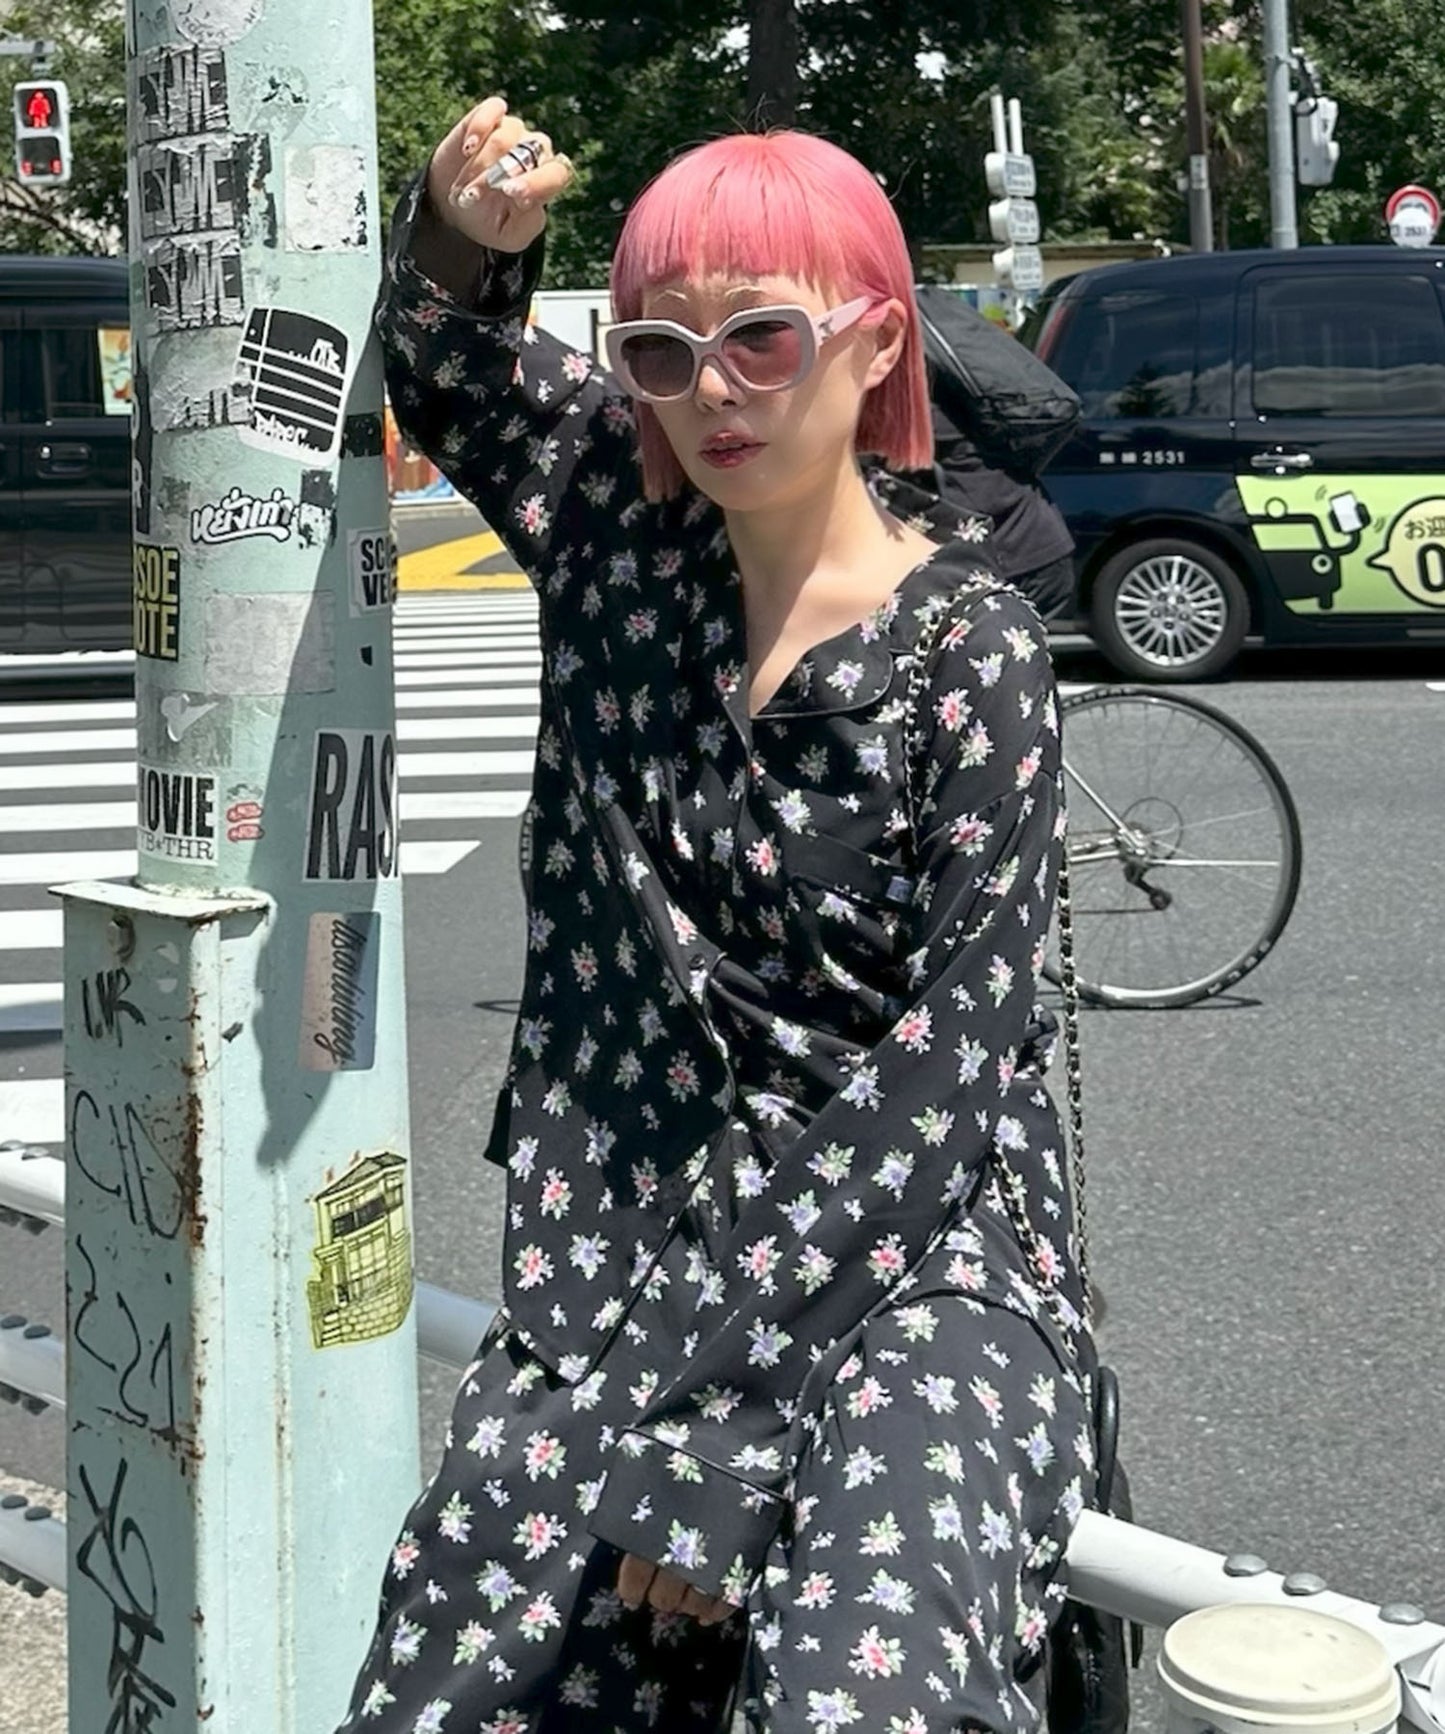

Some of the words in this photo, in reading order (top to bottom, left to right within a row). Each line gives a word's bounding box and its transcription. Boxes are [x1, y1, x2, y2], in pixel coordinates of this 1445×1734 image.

[1142, 451, 1185, 465] 2531
[141, 766, 214, 838] OVIE
[306, 733, 398, 880] RAS
